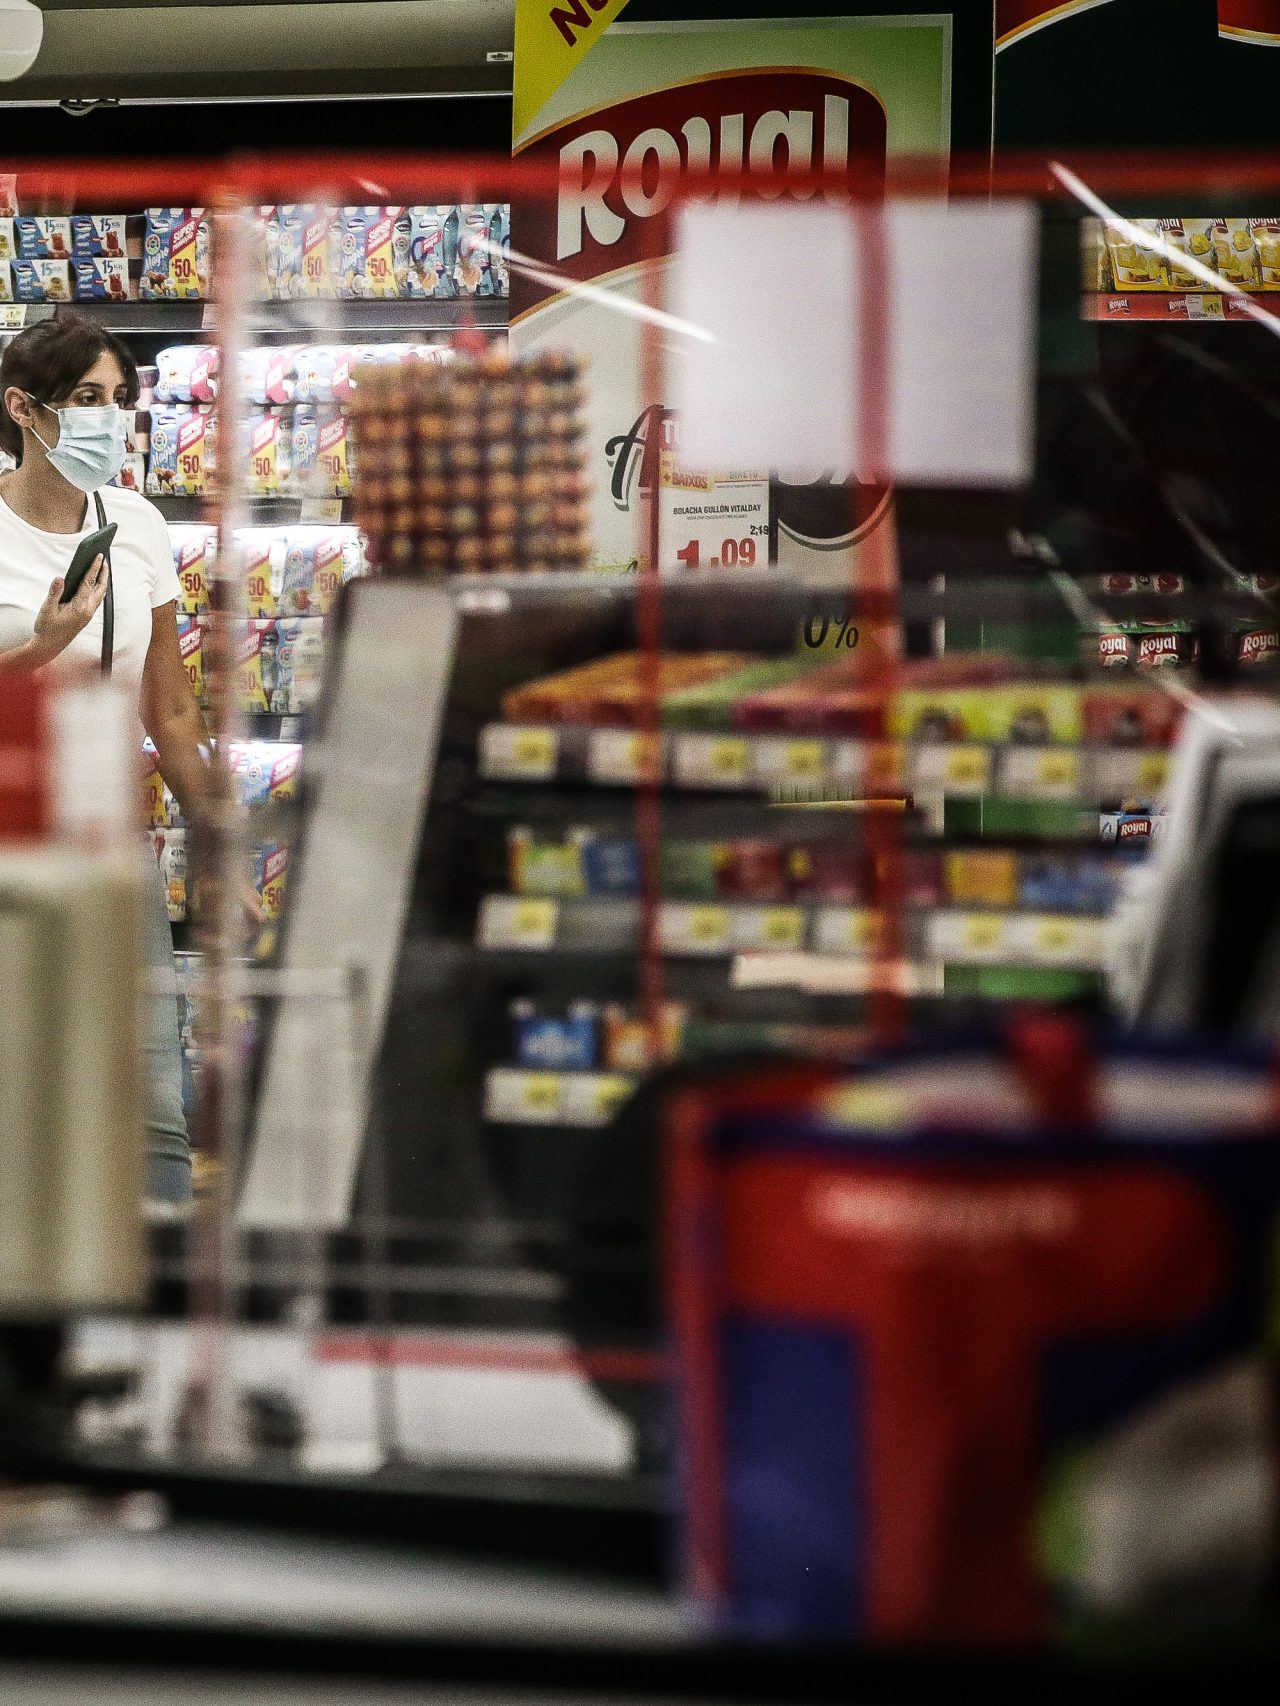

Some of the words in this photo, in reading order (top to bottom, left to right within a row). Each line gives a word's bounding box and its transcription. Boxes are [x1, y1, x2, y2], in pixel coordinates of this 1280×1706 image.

[45, 219, 56, 233] 15
[100, 218, 112, 232] 15
[41, 262, 53, 276] 15
[104, 260, 114, 274] 15
[1108, 299, 1128, 310] Royal
[673, 506, 703, 515] BOLACHA
[731, 503, 762, 513] VITALDAY
[1100, 636, 1127, 654] oyal
[1140, 635, 1177, 656] Royal
[1243, 633, 1280, 654] Royal
[1121, 821, 1148, 836] Royal
